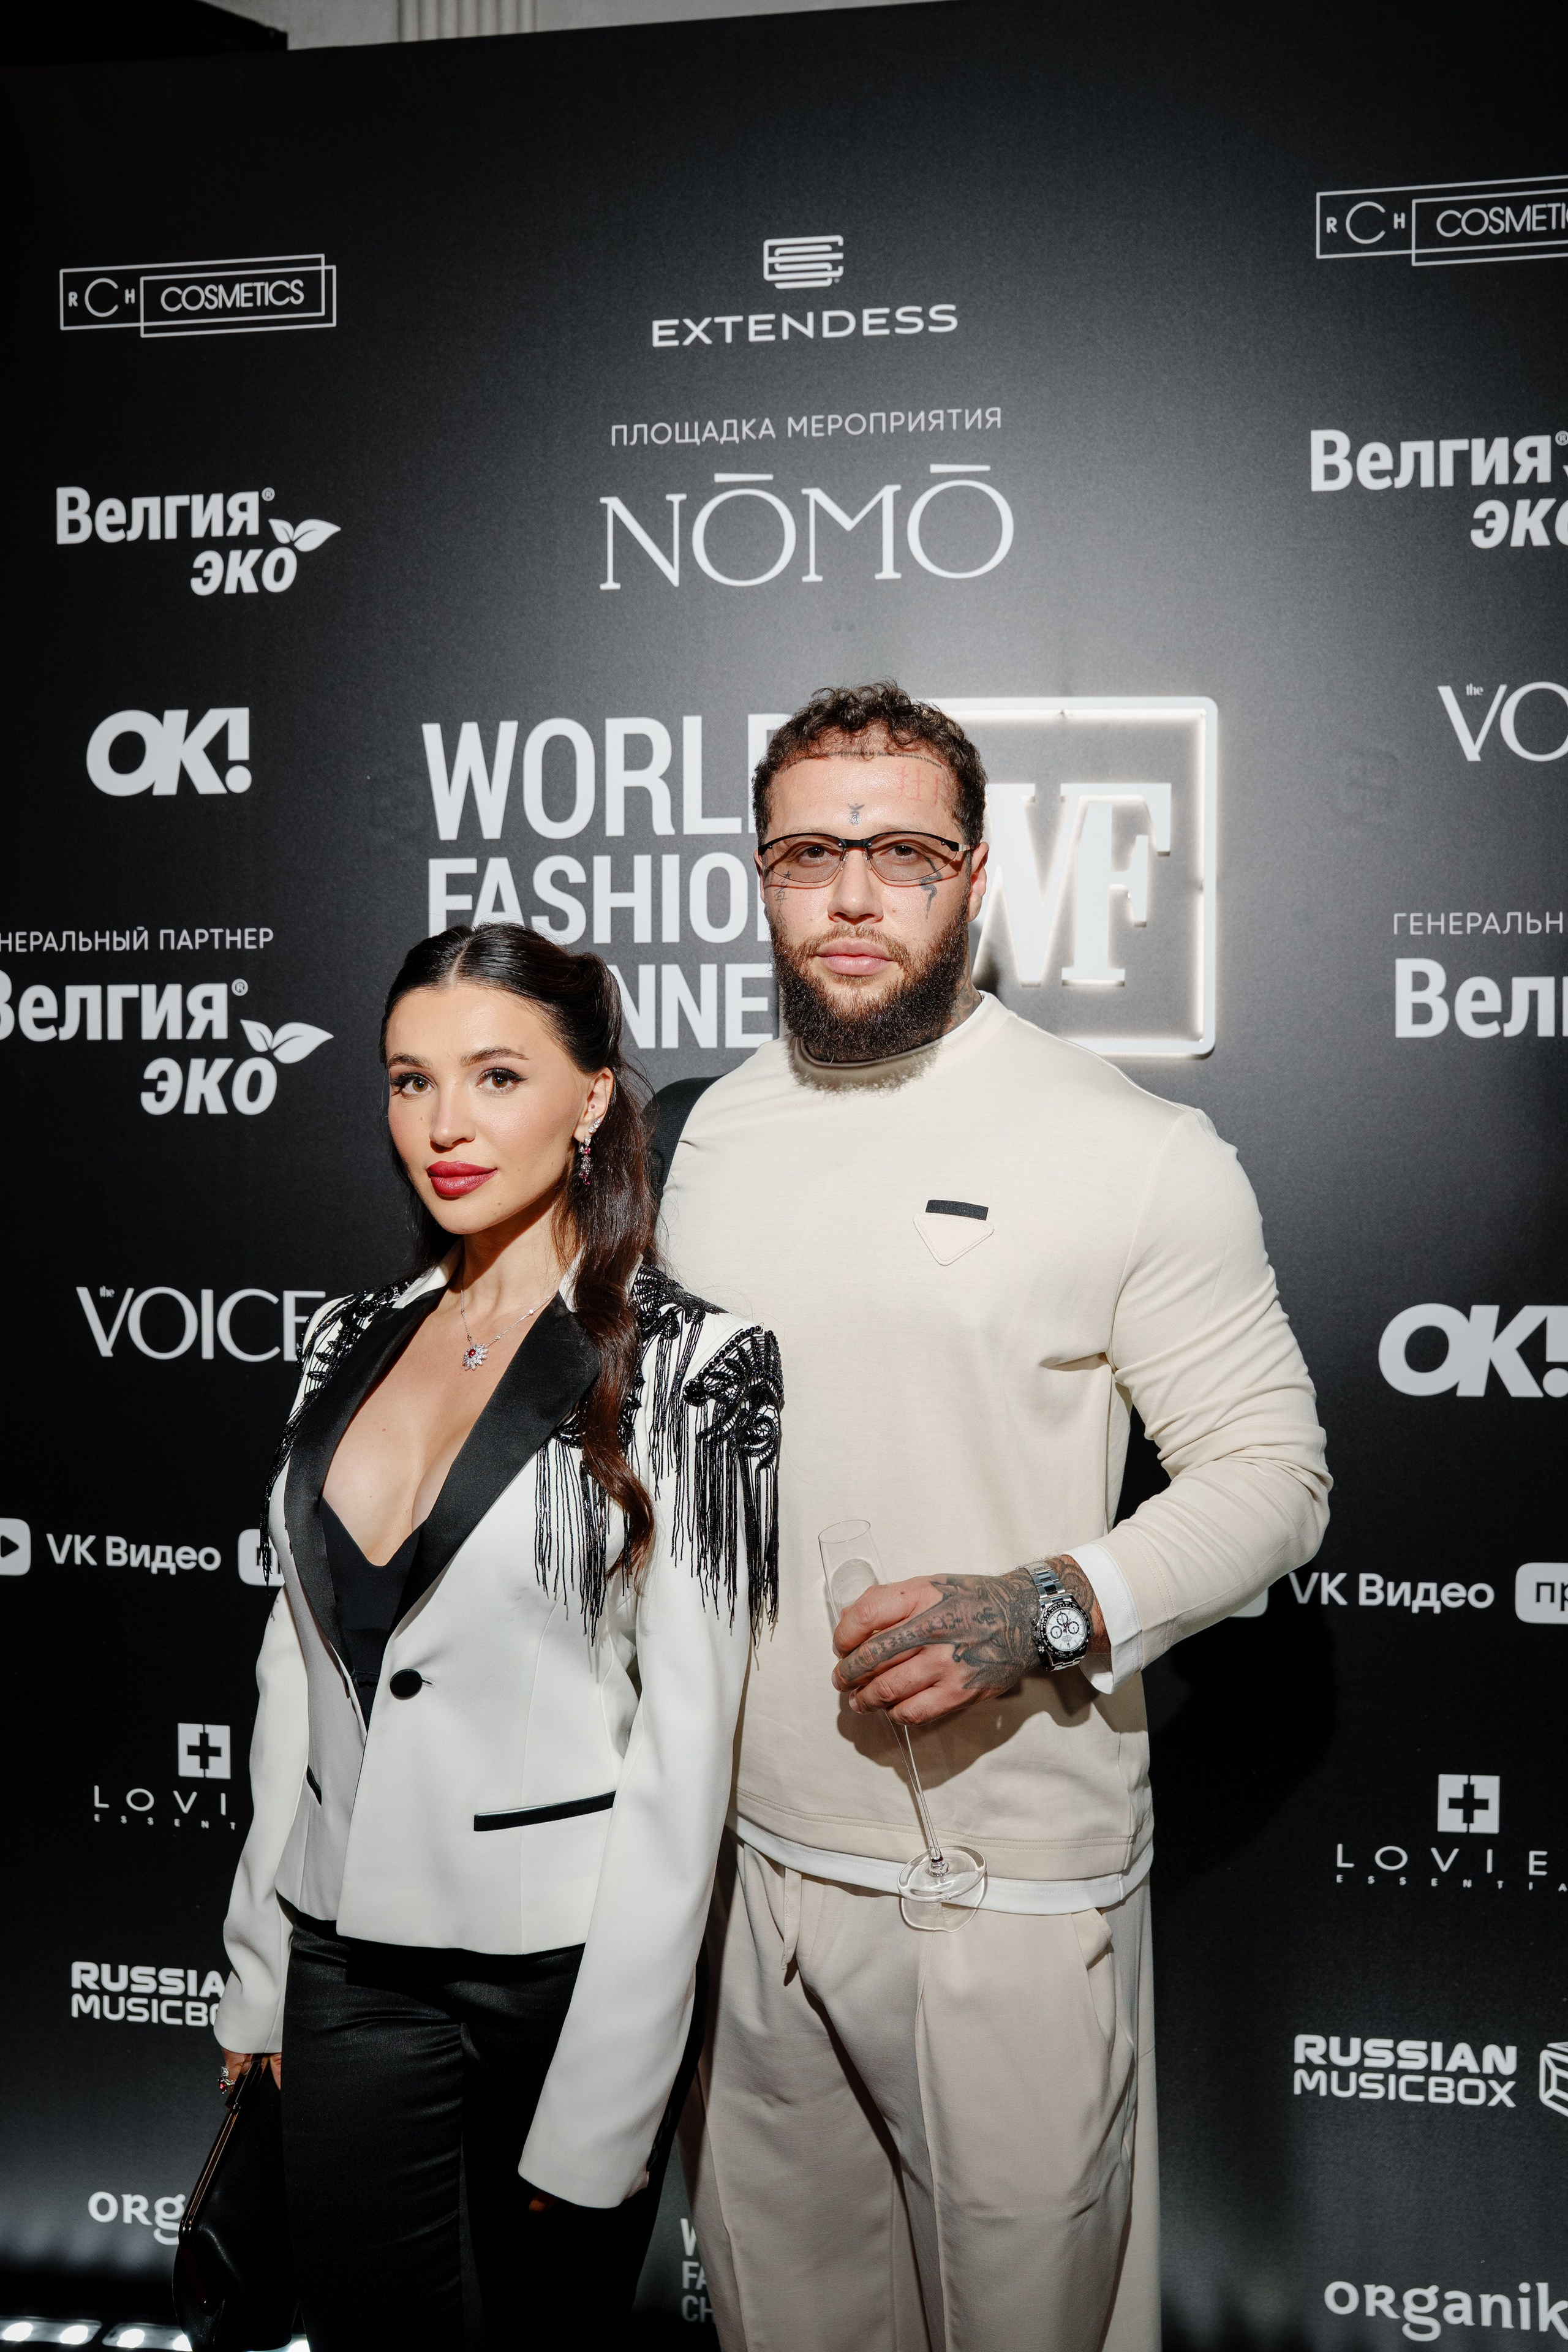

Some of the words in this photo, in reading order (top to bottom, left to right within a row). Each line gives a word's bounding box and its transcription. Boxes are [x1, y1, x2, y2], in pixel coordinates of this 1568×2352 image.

[160, 279, 304, 312] COSMETICS
[652, 304, 958, 347] EXTENDESS
[611, 417, 776, 447] ПЛОЩАДКА
[788, 407, 1001, 438] МЕРОПРИЯТИЯ
[1466, 683, 1484, 696] the
[86, 707, 252, 797] OK!
[429, 852, 771, 945] FASHIO
[159, 927, 274, 951] ПАРТНЕР
[1393, 911, 1563, 935] ГЕНЕРАЛЬН
[1395, 957, 1568, 1039] Вел
[99, 1286, 115, 1298] the
[77, 1286, 326, 1362] VOICE
[1378, 1303, 1568, 1398] OK!
[46, 1533, 97, 1566] VK
[105, 1536, 222, 1575] Видео
[1288, 1572, 1348, 1605] VK
[1359, 1573, 1495, 1614] Видео
[94, 1785, 227, 1815] LOVI
[94, 1814, 236, 1830] ESSENT
[71, 1961, 226, 1998] RUSSIA
[71, 1993, 219, 2027] MUSICB
[1294, 2034, 1517, 2076] RUSSIAN
[1294, 2068, 1517, 2108] MUSICBOX
